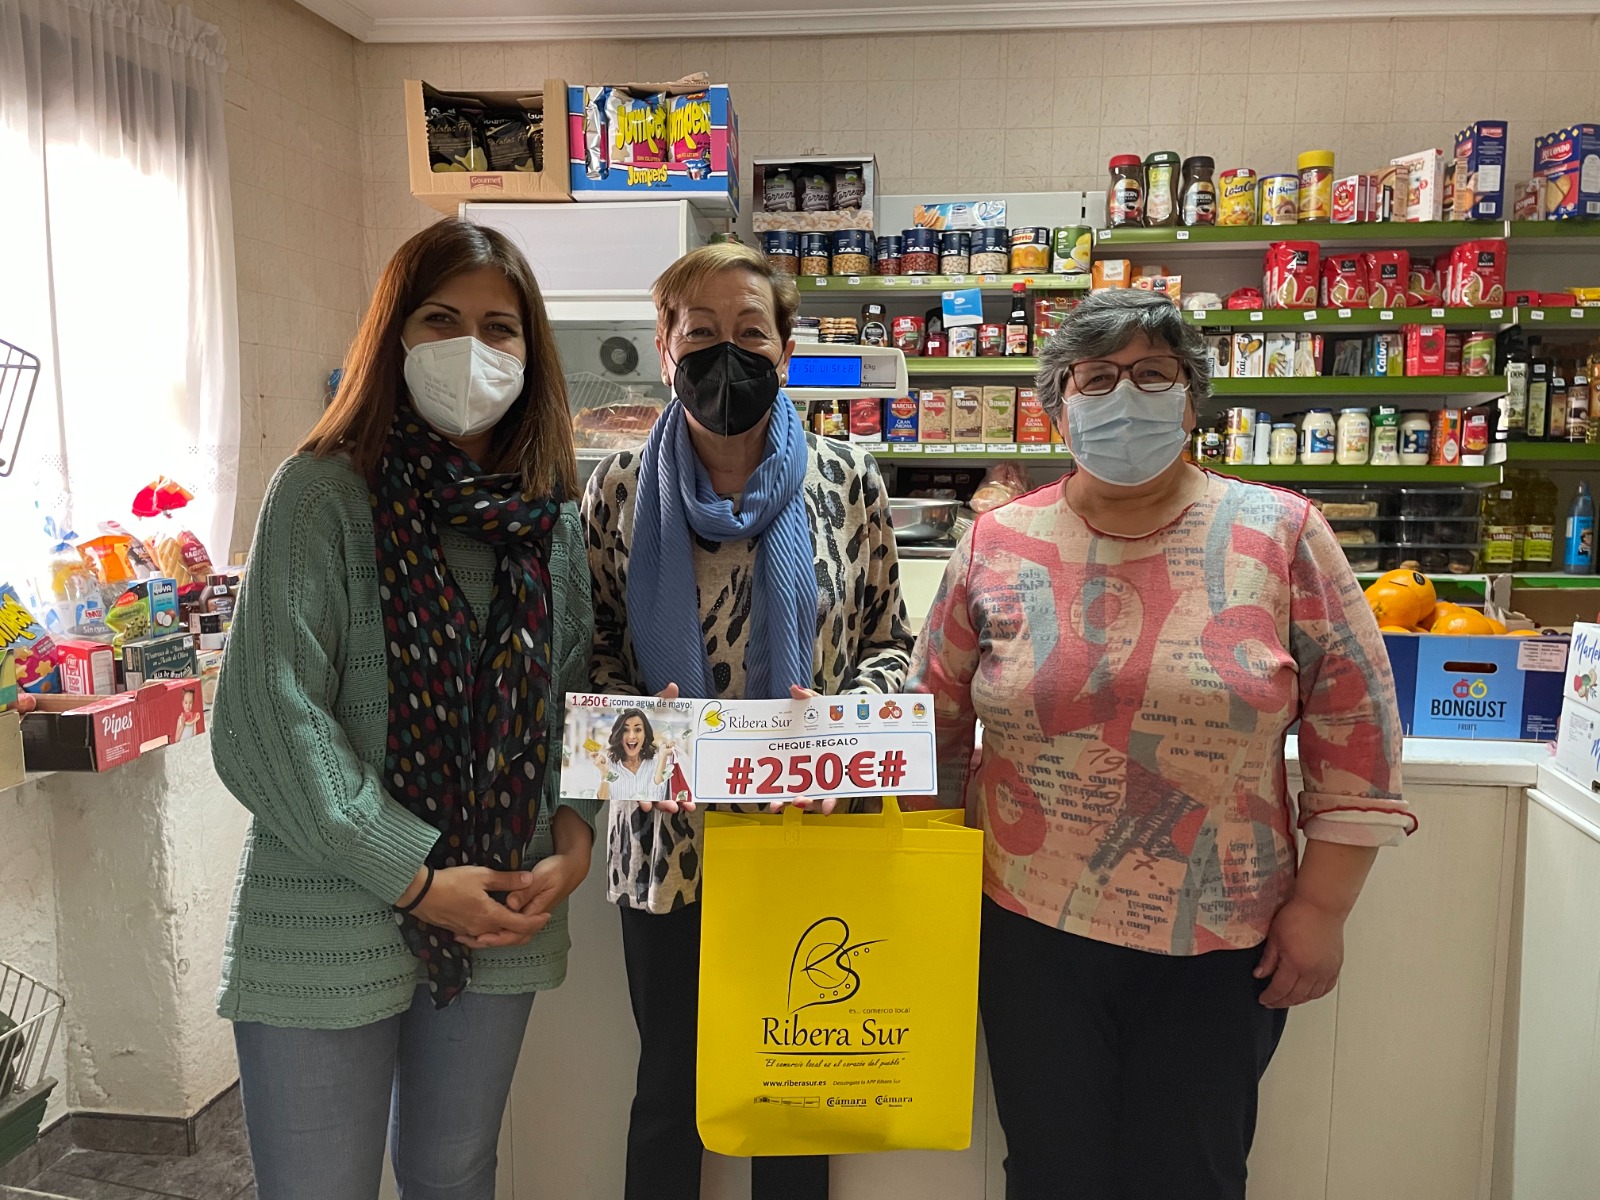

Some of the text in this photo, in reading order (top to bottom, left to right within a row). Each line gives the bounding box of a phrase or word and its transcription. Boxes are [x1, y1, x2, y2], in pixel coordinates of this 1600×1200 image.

[470, 176, 502, 185] Gourmet
[627, 163, 668, 187] Jumpers
[1376, 341, 1388, 373] Calvo
[988, 400, 1010, 408] BONKA
[68, 676, 80, 687] TOP
[572, 695, 693, 710] 1.250 € ¡como agua de mayo!
[1430, 698, 1507, 719] BONGUST
[101, 710, 133, 741] Pipes
[728, 716, 768, 730] Ribera
[771, 715, 793, 729] Sur
[768, 737, 859, 751] CHEQUE-REGALO
[894, 1006, 911, 1014] local
[761, 1013, 910, 1047] Ribera Sur
[776, 1060, 804, 1068] comercio
[805, 1059, 821, 1068] local
[867, 1058, 880, 1067] del
[762, 1079, 827, 1087] www.riberasur.es
[826, 1096, 867, 1108] Cámara
[875, 1094, 913, 1106] Cámara
